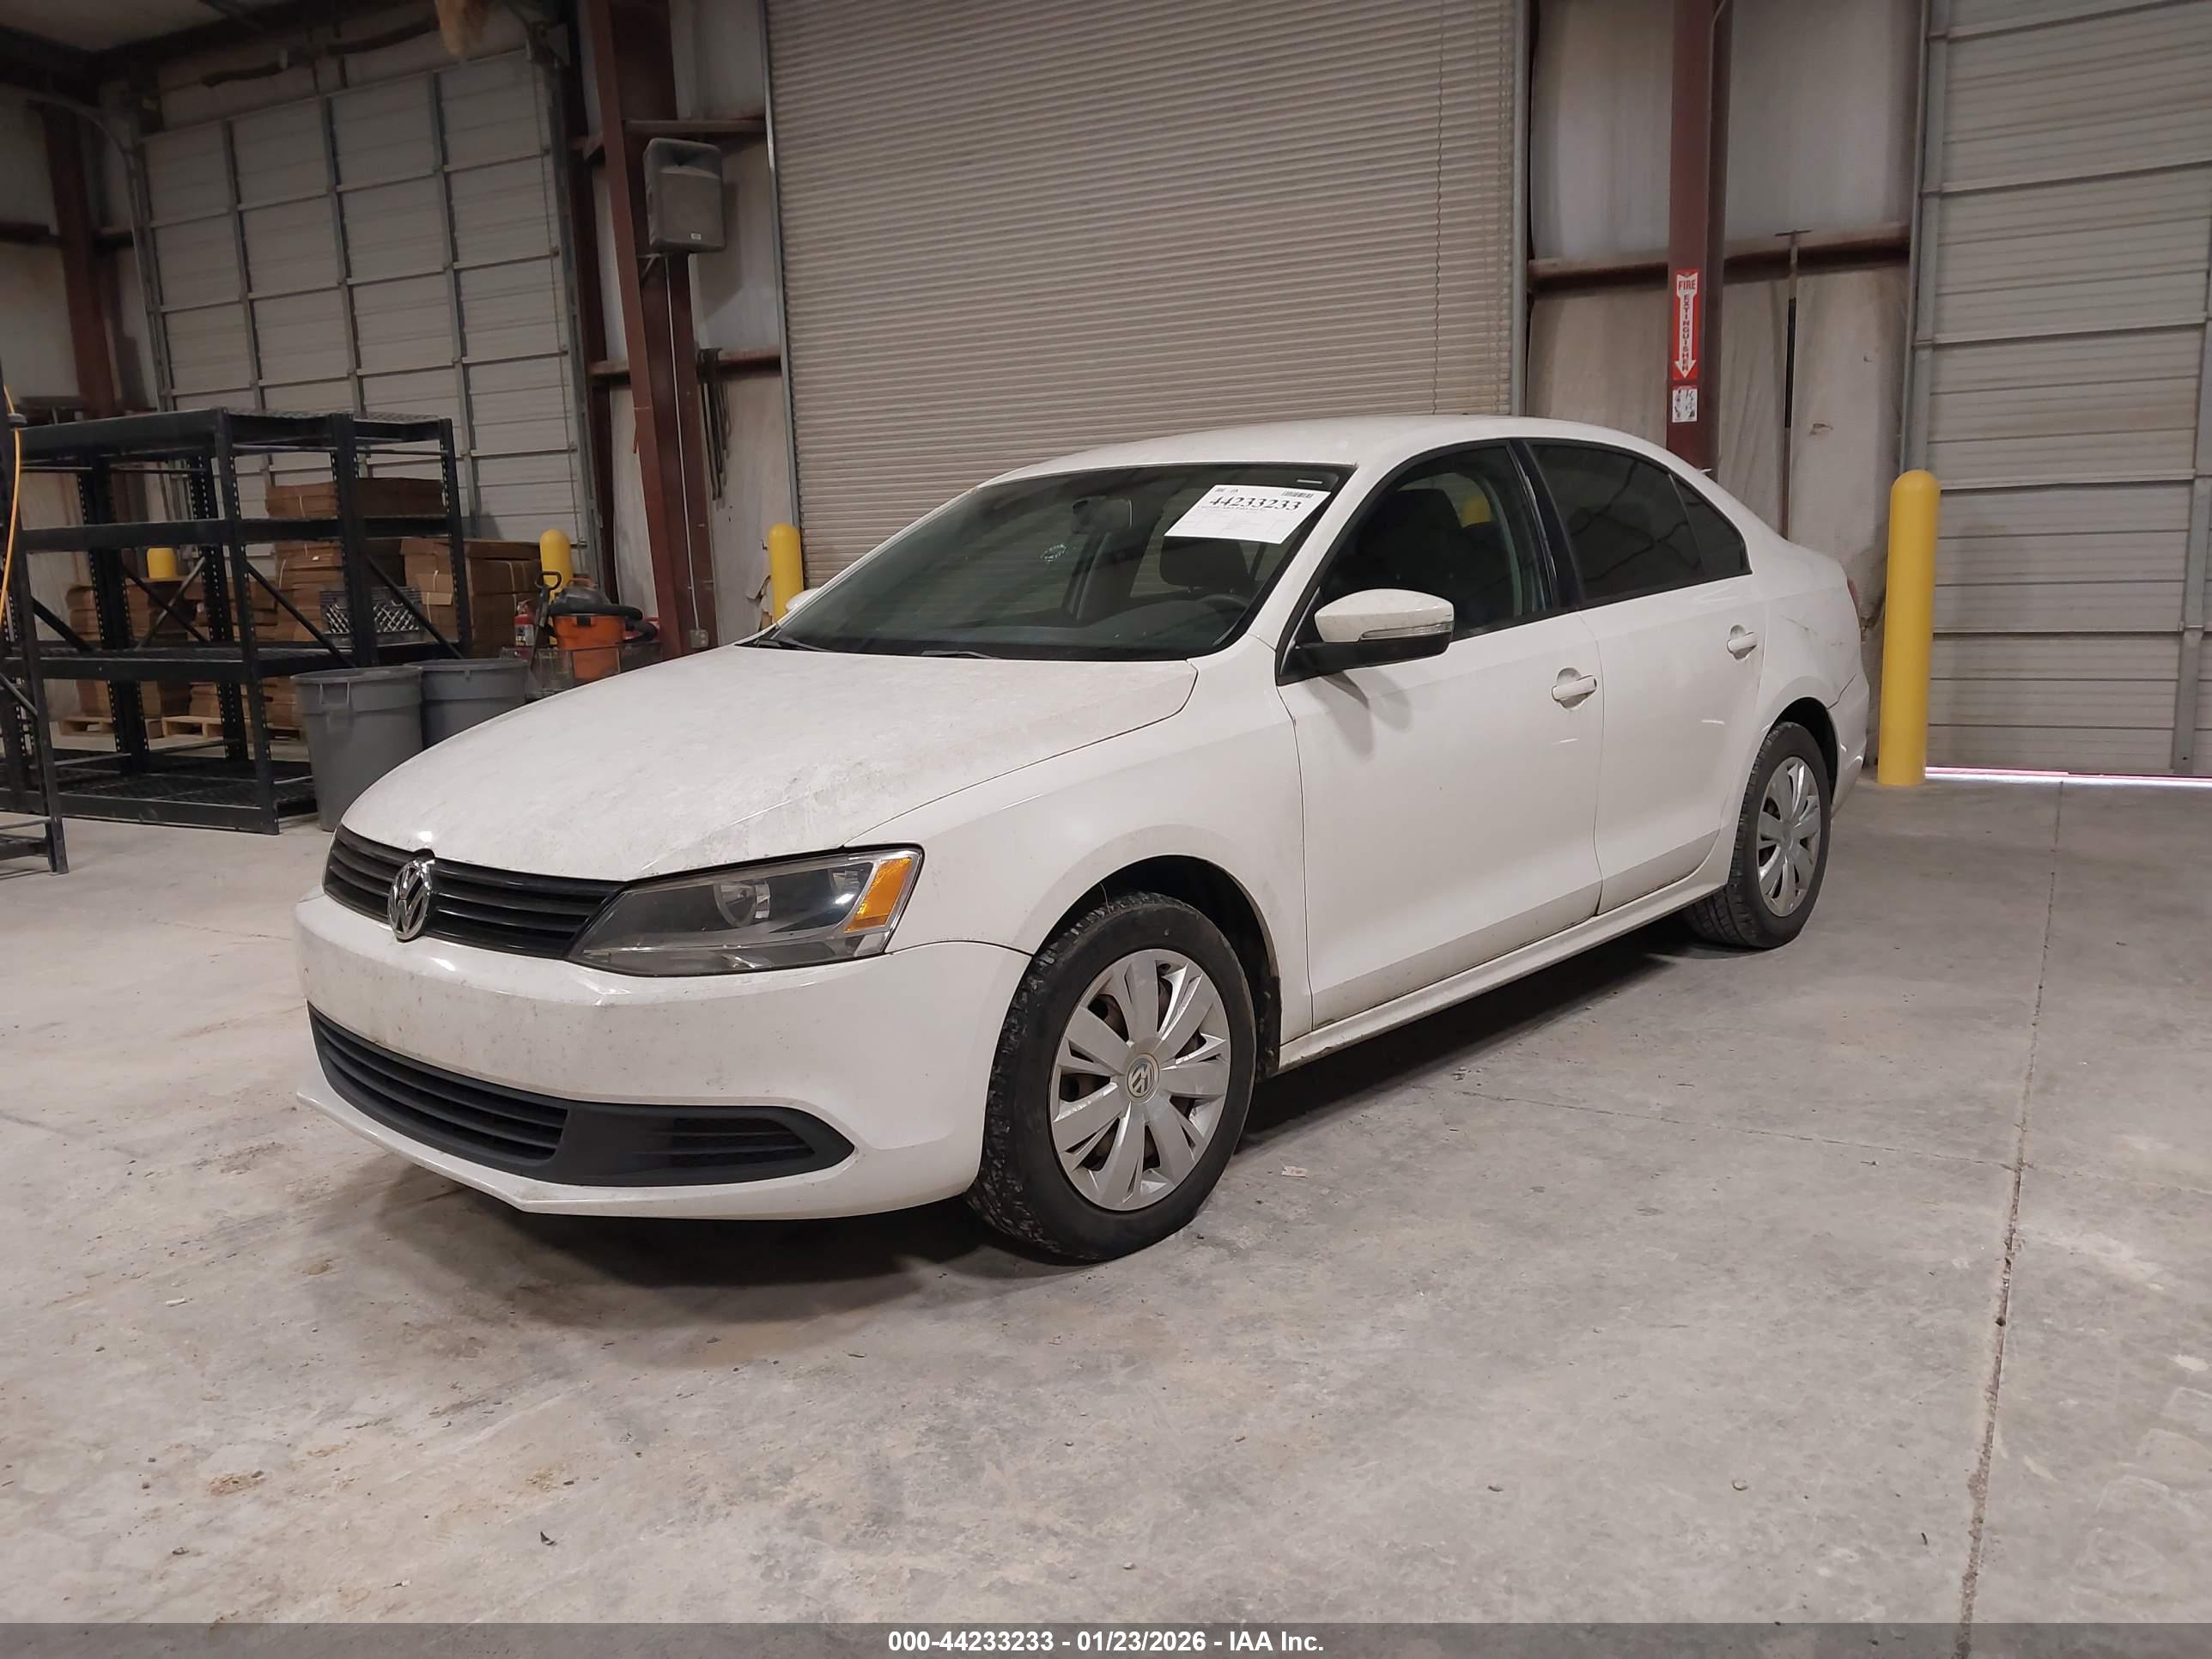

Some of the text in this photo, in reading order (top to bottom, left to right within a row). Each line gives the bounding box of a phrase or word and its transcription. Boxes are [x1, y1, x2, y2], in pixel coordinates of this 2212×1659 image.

[1678, 280, 1696, 290] FIRE
[1682, 295, 1691, 371] EXTINGUISHER
[1209, 496, 1302, 510] 44233233
